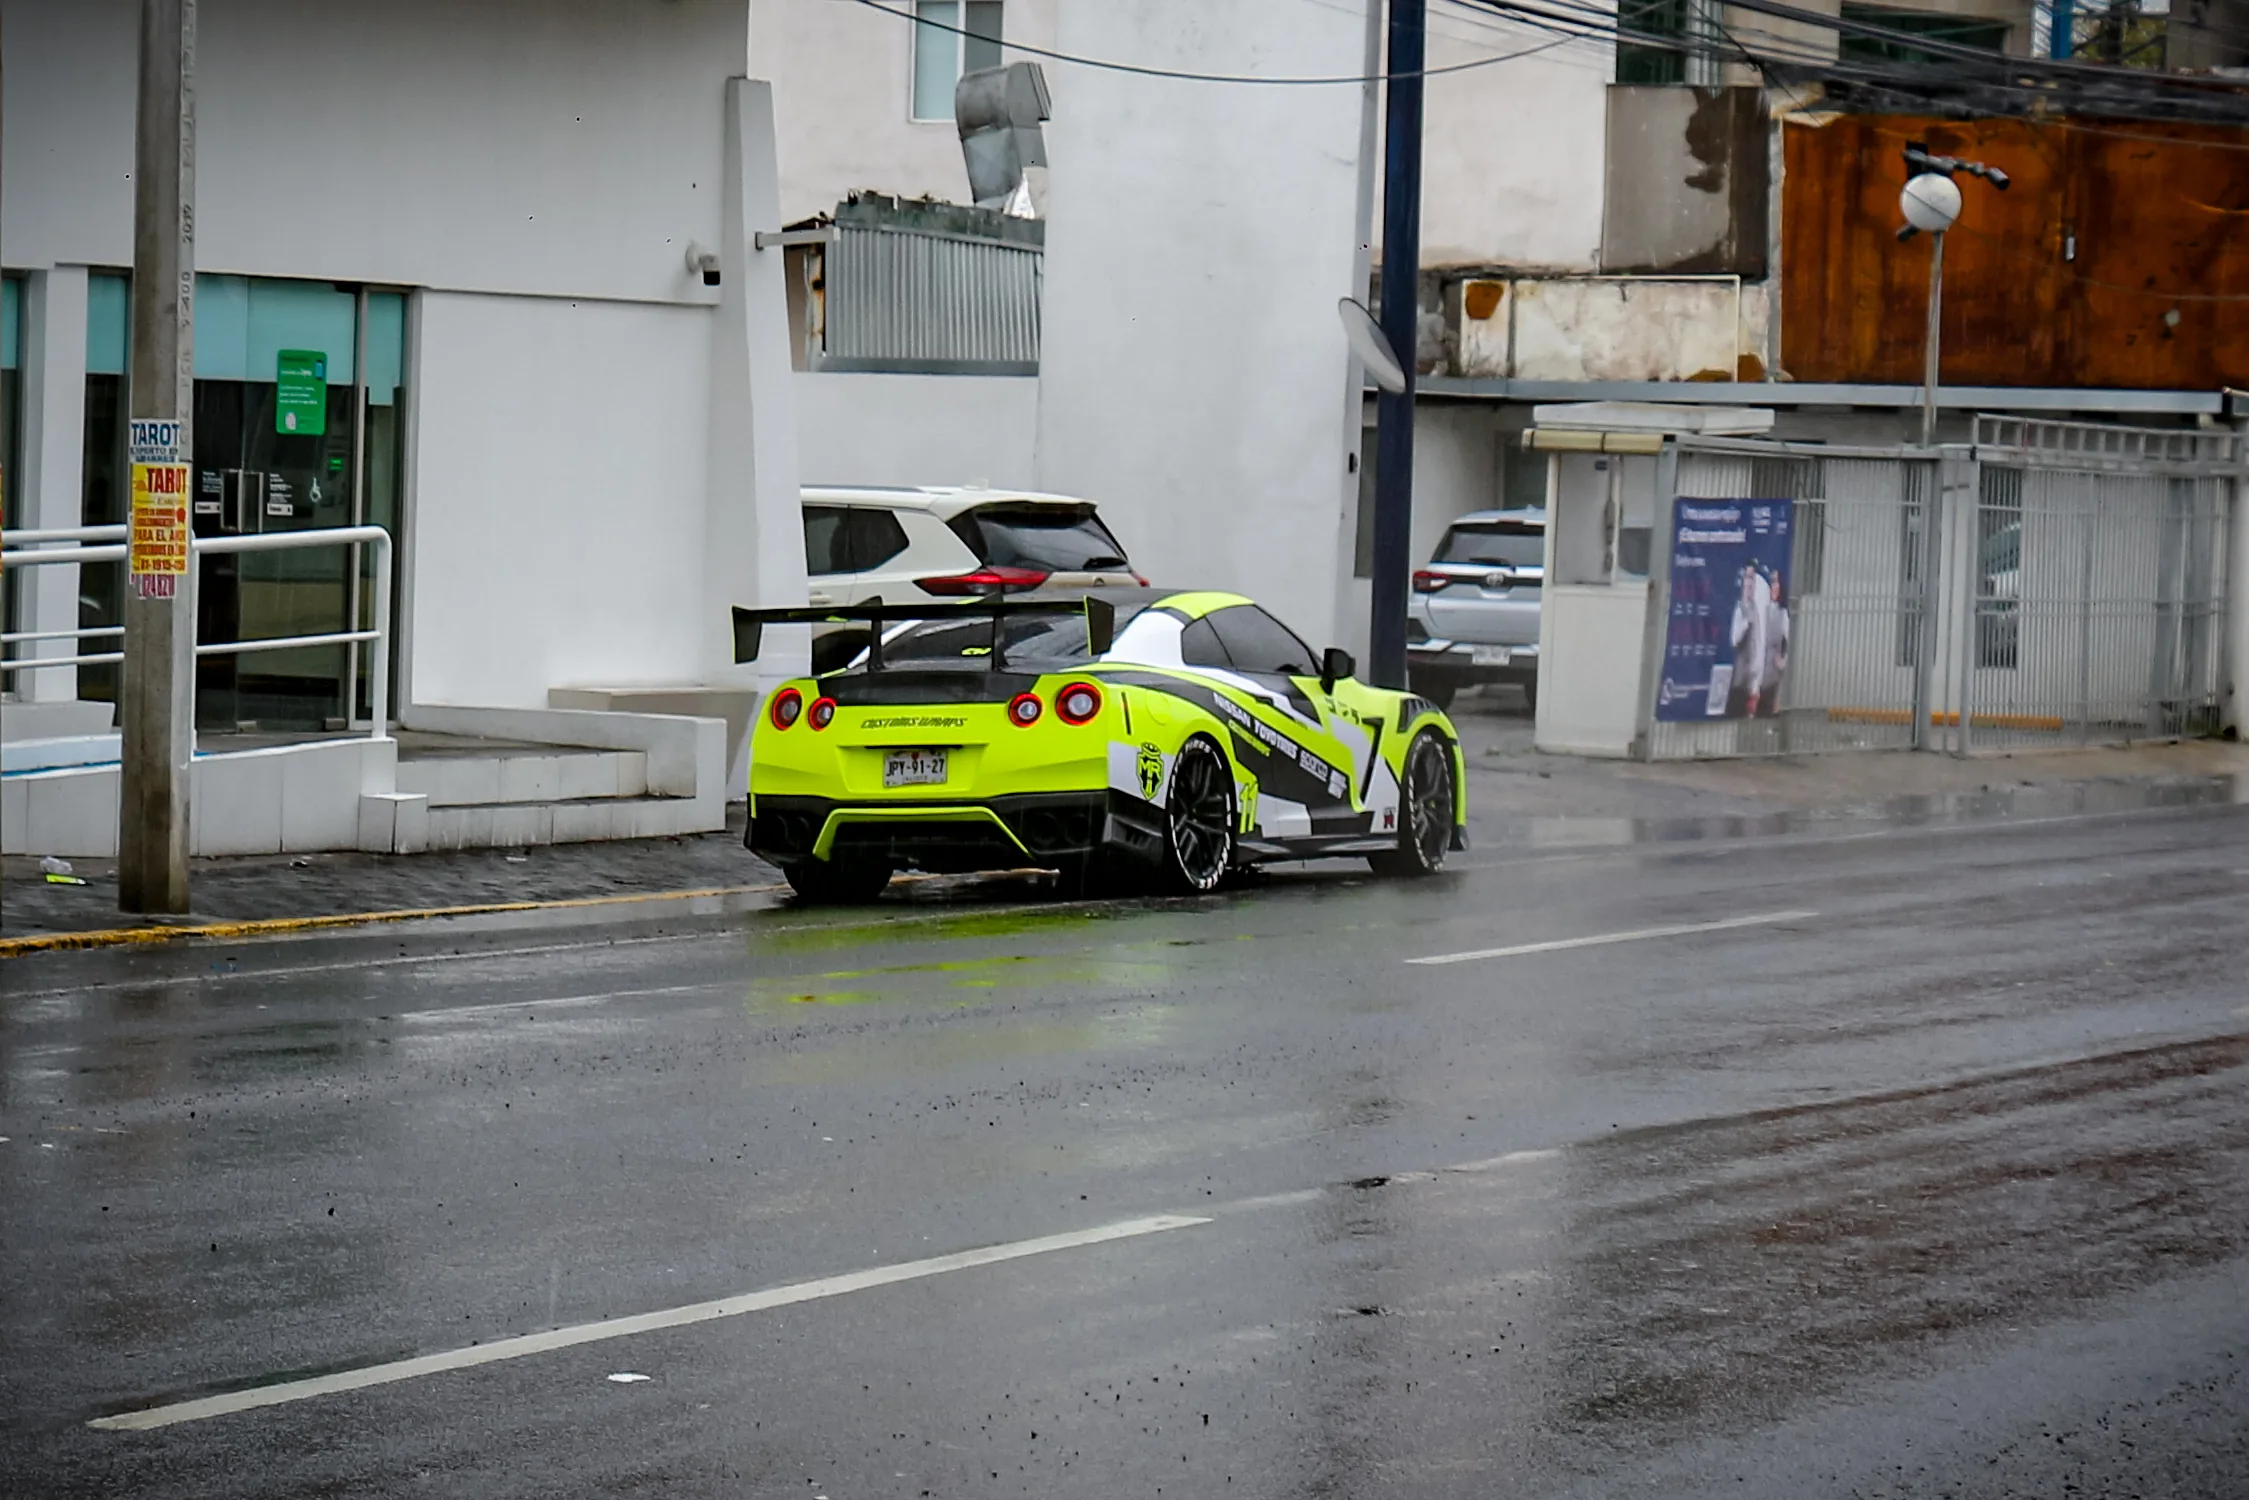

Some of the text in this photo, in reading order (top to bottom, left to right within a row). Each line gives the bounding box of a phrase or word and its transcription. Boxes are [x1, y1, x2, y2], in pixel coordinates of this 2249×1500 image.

[131, 423, 180, 446] TAROT
[147, 467, 187, 493] TAROT
[886, 758, 945, 777] JPY-91-27
